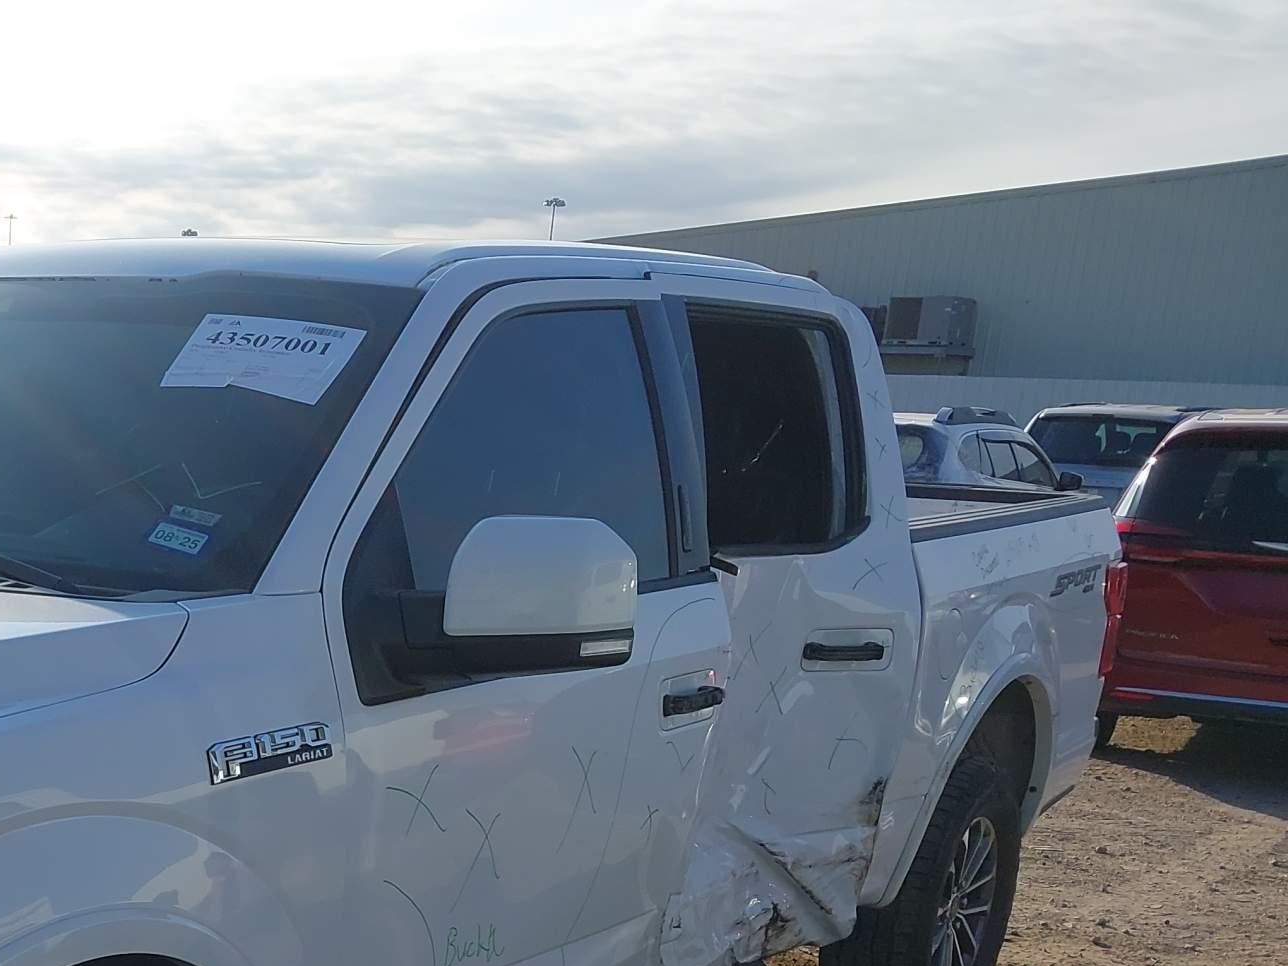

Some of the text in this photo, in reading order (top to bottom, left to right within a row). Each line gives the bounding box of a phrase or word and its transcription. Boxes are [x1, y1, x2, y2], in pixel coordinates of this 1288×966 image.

[206, 330, 332, 356] 43507001
[154, 529, 176, 543] 08
[178, 535, 201, 550] 25
[1049, 564, 1102, 597] SPORT
[286, 747, 329, 765] LARIAT
